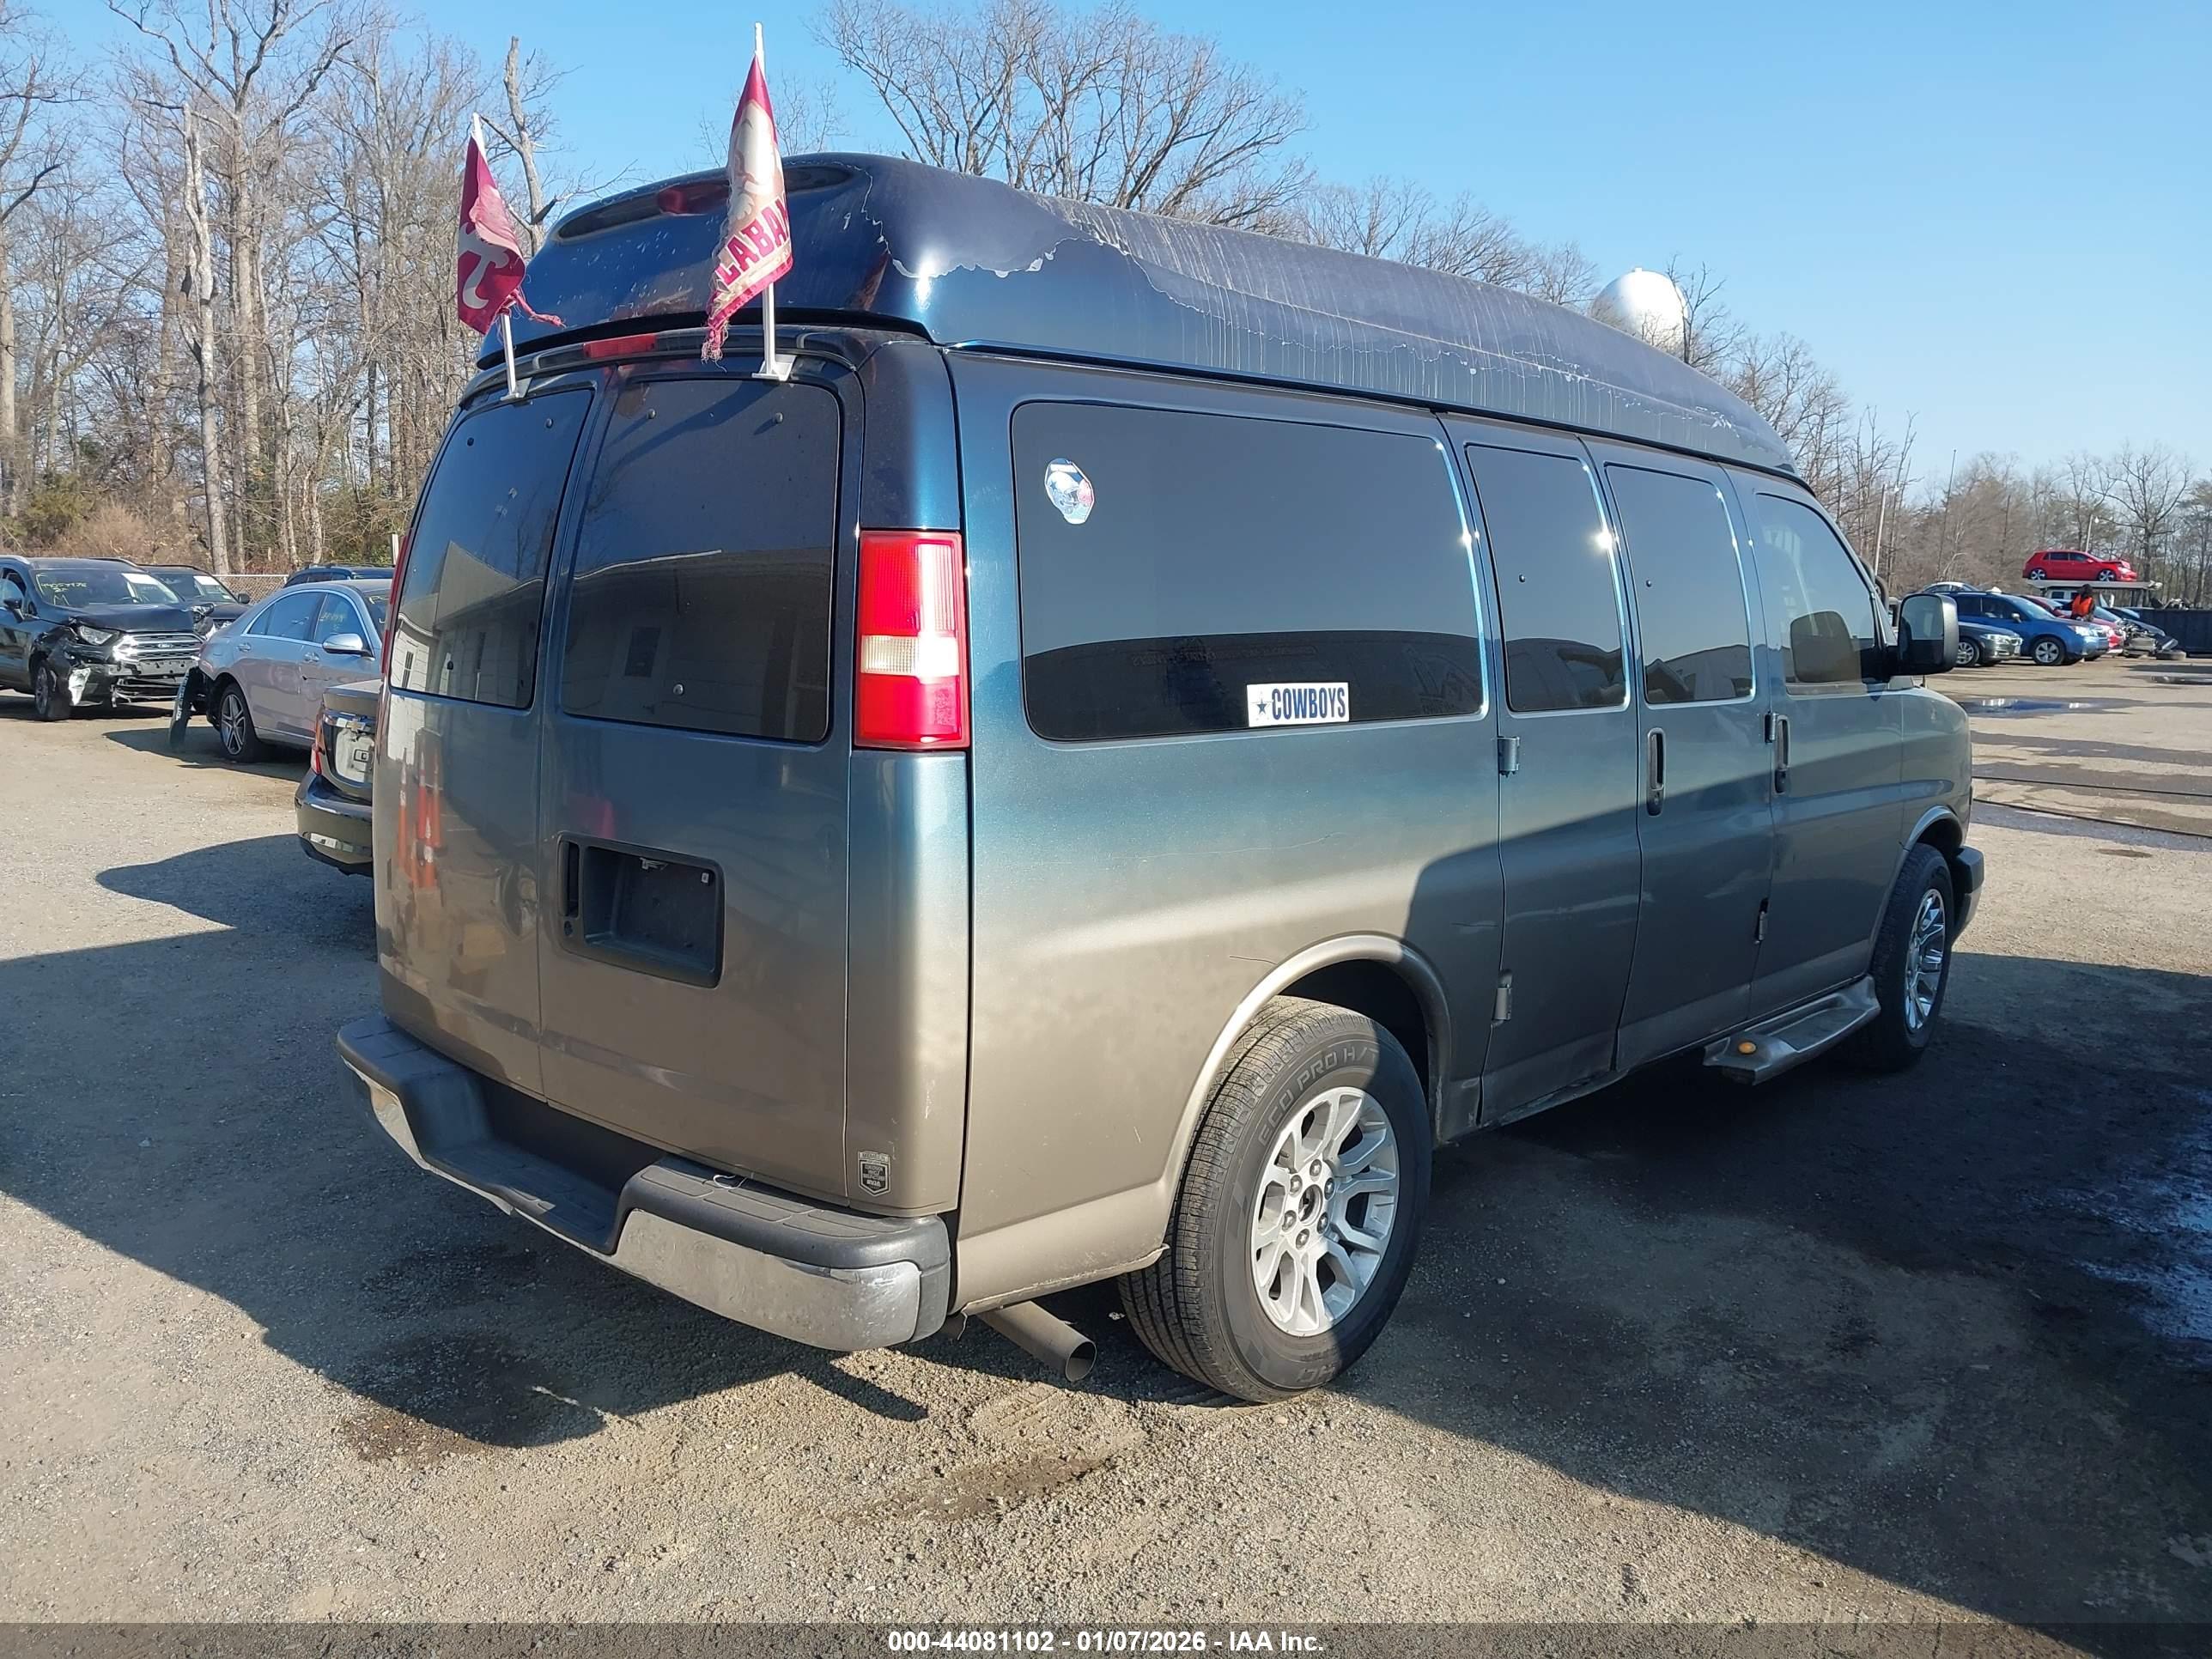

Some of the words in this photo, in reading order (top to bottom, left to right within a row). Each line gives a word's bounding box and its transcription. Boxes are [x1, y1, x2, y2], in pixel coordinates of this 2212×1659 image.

[1272, 687, 1346, 720] COWBOYS
[1258, 1091, 1293, 1146] ECO
[1297, 1051, 1338, 1091] PRO
